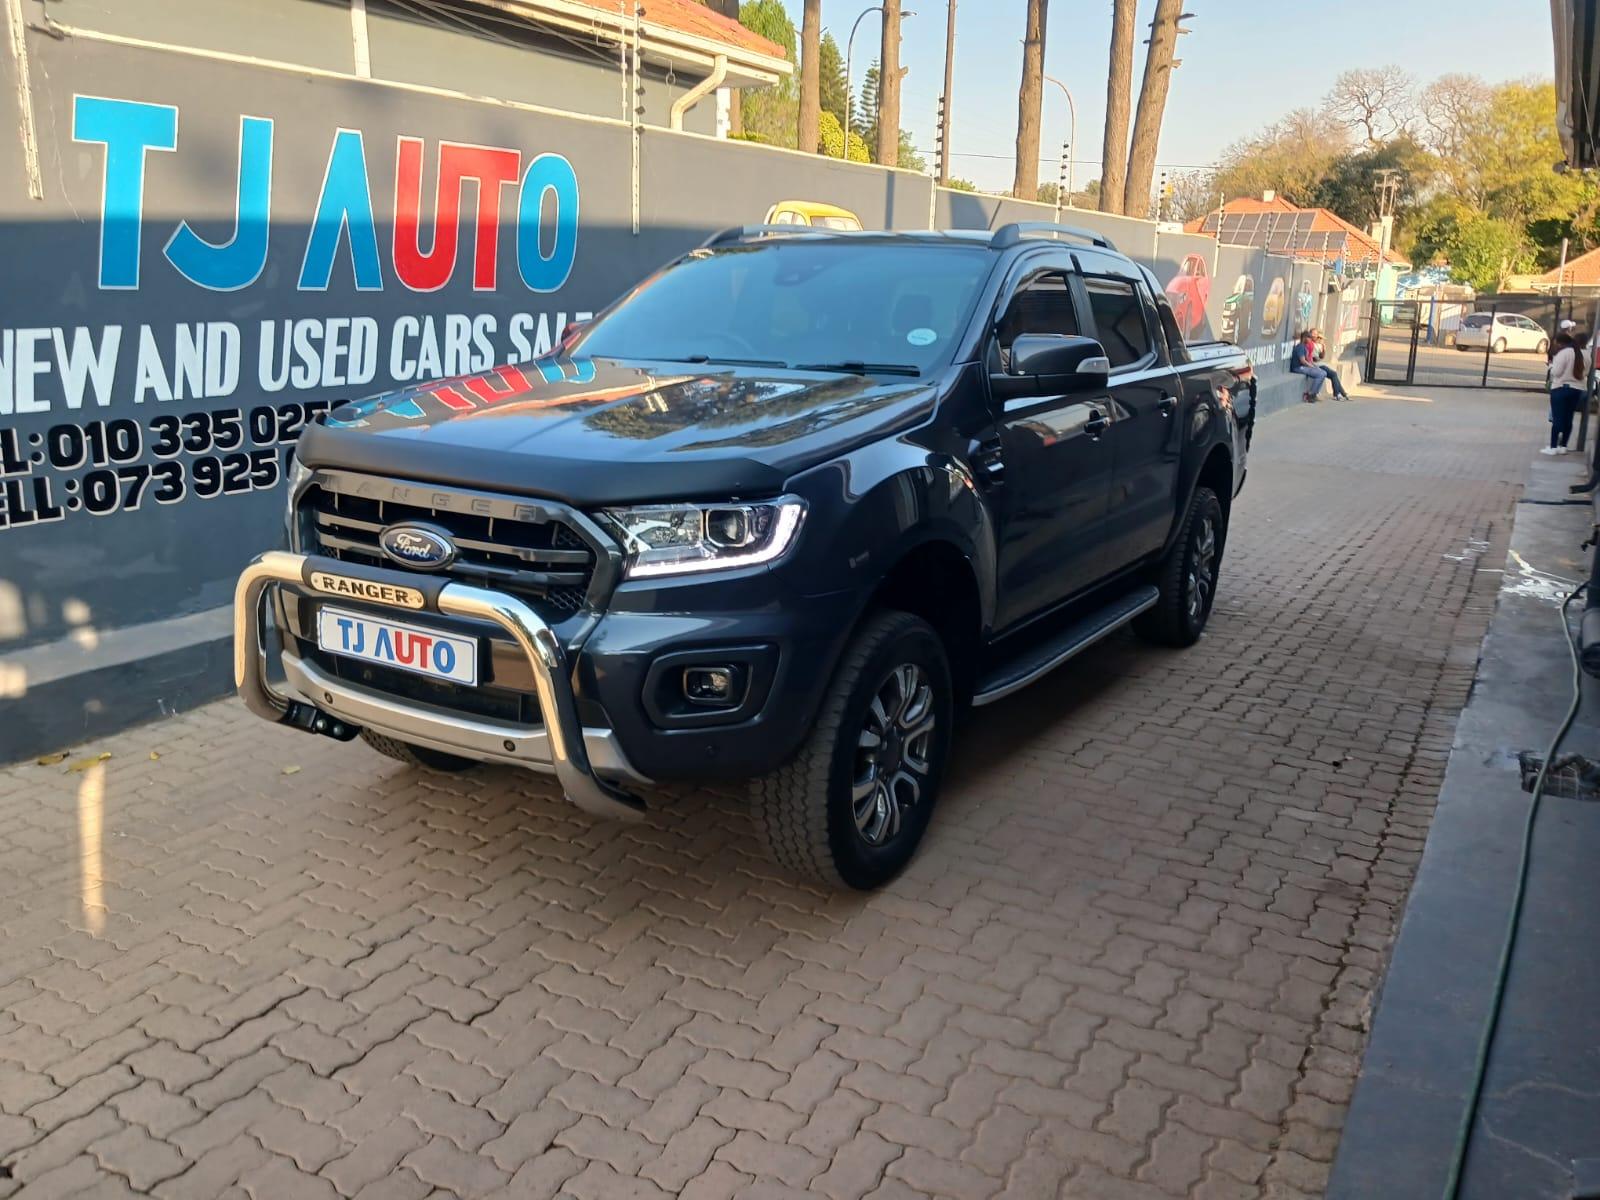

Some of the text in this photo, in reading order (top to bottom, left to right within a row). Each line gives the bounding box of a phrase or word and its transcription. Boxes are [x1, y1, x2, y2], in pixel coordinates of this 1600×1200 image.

[73, 93, 580, 292] TJ AUTO
[134, 322, 241, 403] AND
[258, 318, 377, 391] USED
[390, 314, 497, 380] CARS
[149, 407, 243, 459] 335
[192, 448, 280, 499] 925
[393, 533, 431, 559] Ford
[322, 576, 409, 604] RANGER
[337, 618, 456, 674] TJ AUTO
